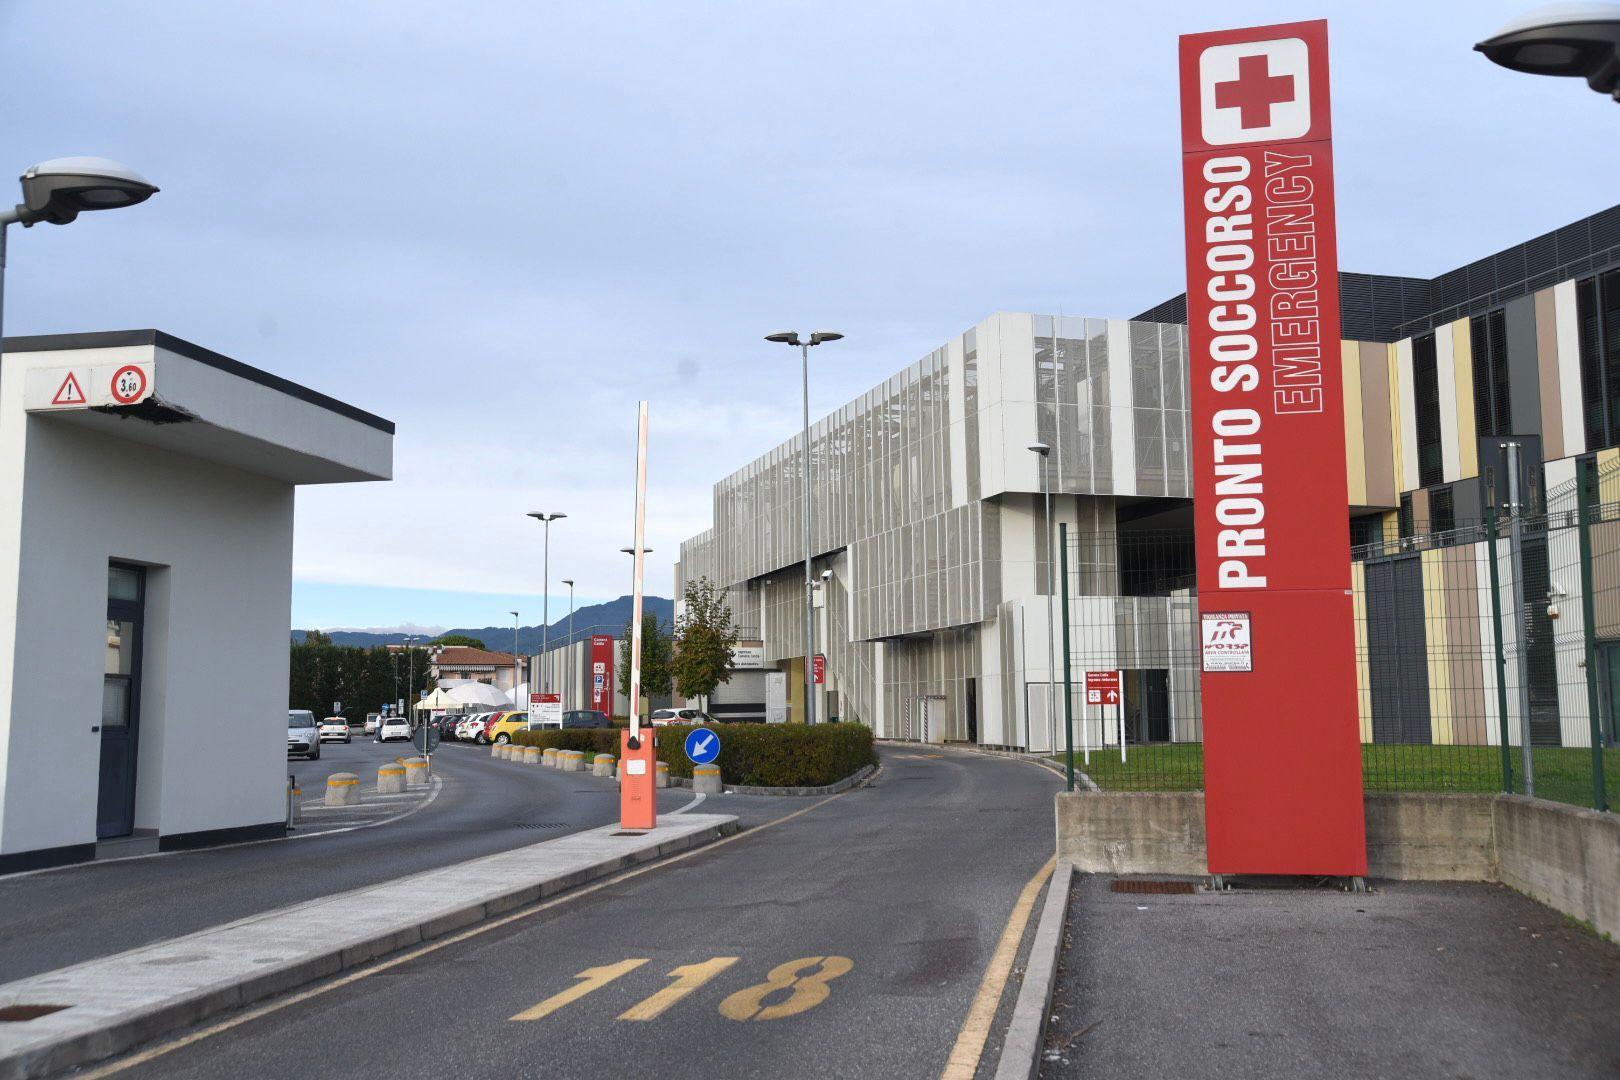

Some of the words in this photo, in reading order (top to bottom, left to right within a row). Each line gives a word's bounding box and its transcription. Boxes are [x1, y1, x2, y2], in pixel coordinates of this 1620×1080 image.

[1203, 155, 1260, 392] SOCCORSO
[1264, 151, 1323, 414] EMERGENCY
[1212, 408, 1267, 588] PRONTO
[508, 955, 854, 1022] 118
